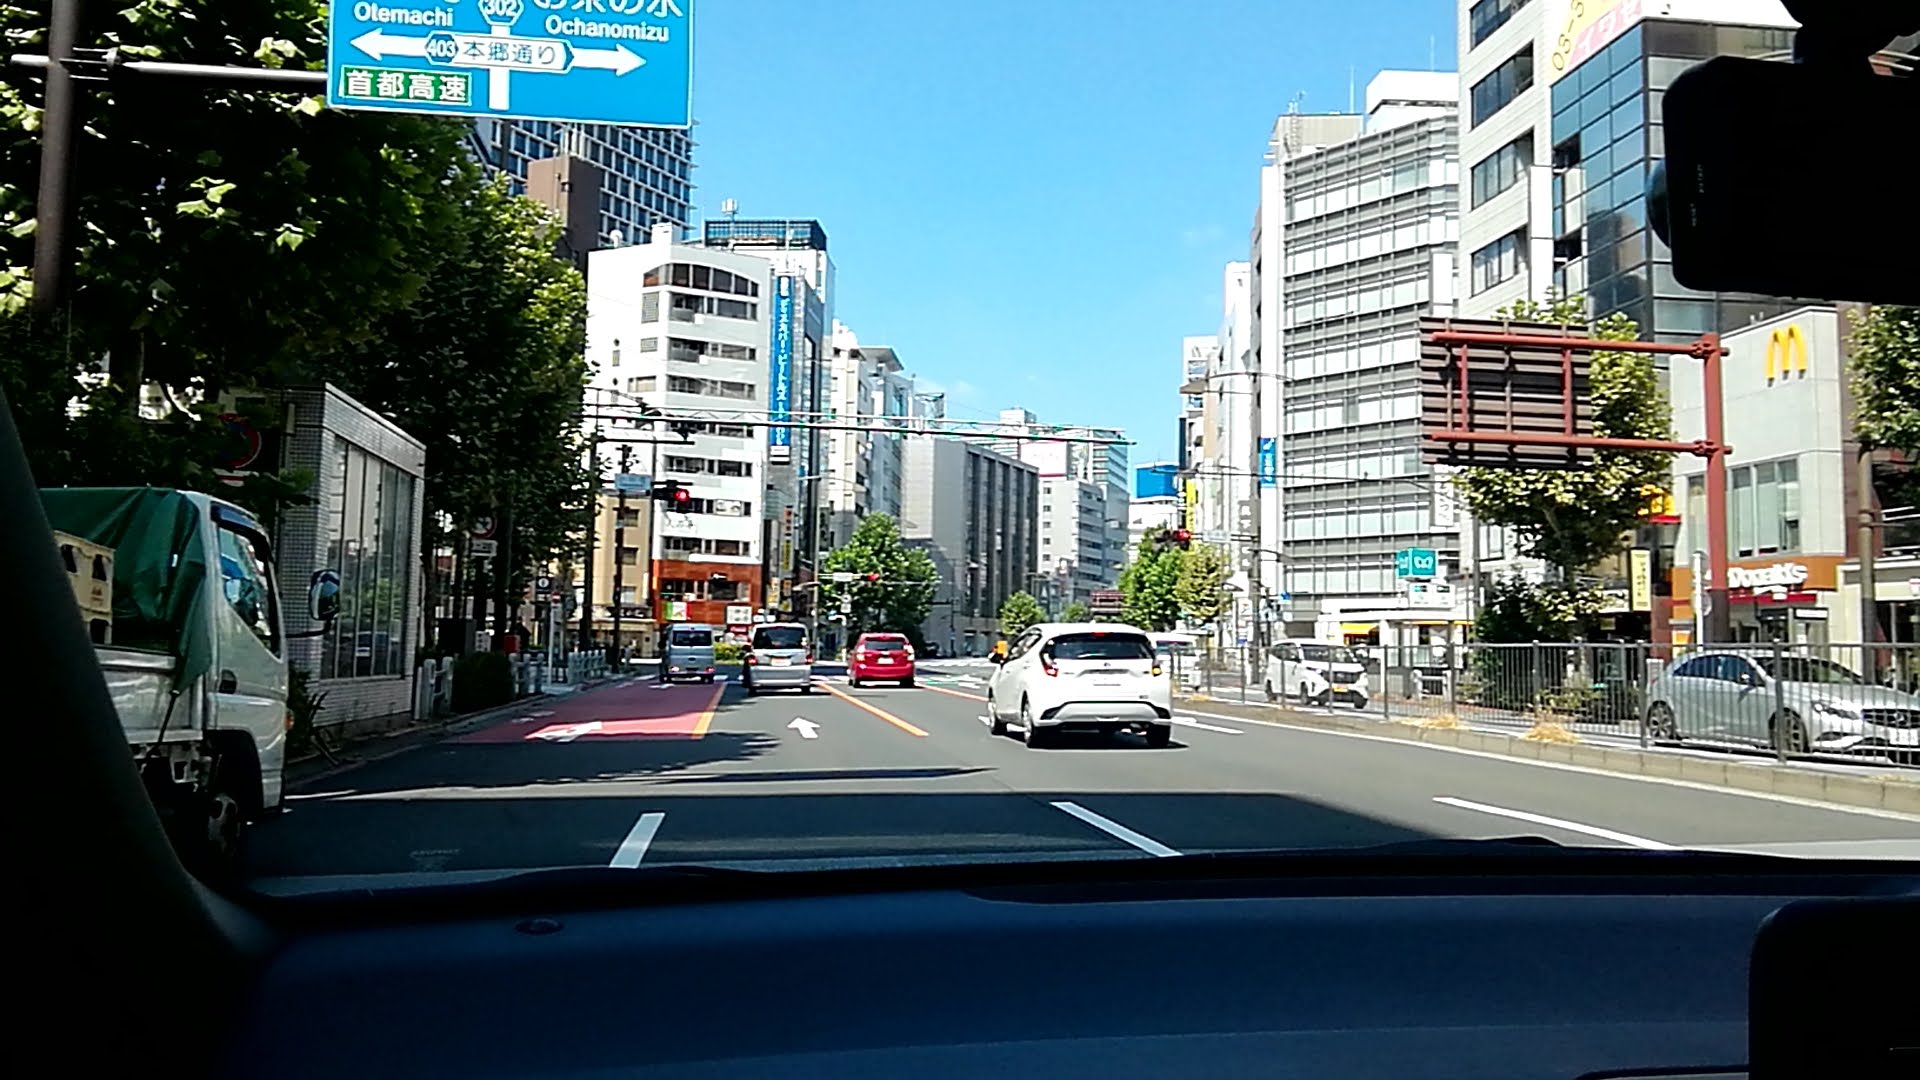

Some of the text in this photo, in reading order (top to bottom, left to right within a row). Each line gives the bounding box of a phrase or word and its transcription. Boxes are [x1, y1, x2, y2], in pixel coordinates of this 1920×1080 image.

[353, 1, 454, 27] Otemachi
[545, 14, 669, 43] Ochanomizu
[428, 39, 457, 58] 403
[463, 39, 556, 66] 本郷通り
[346, 69, 467, 102] 首都高速
